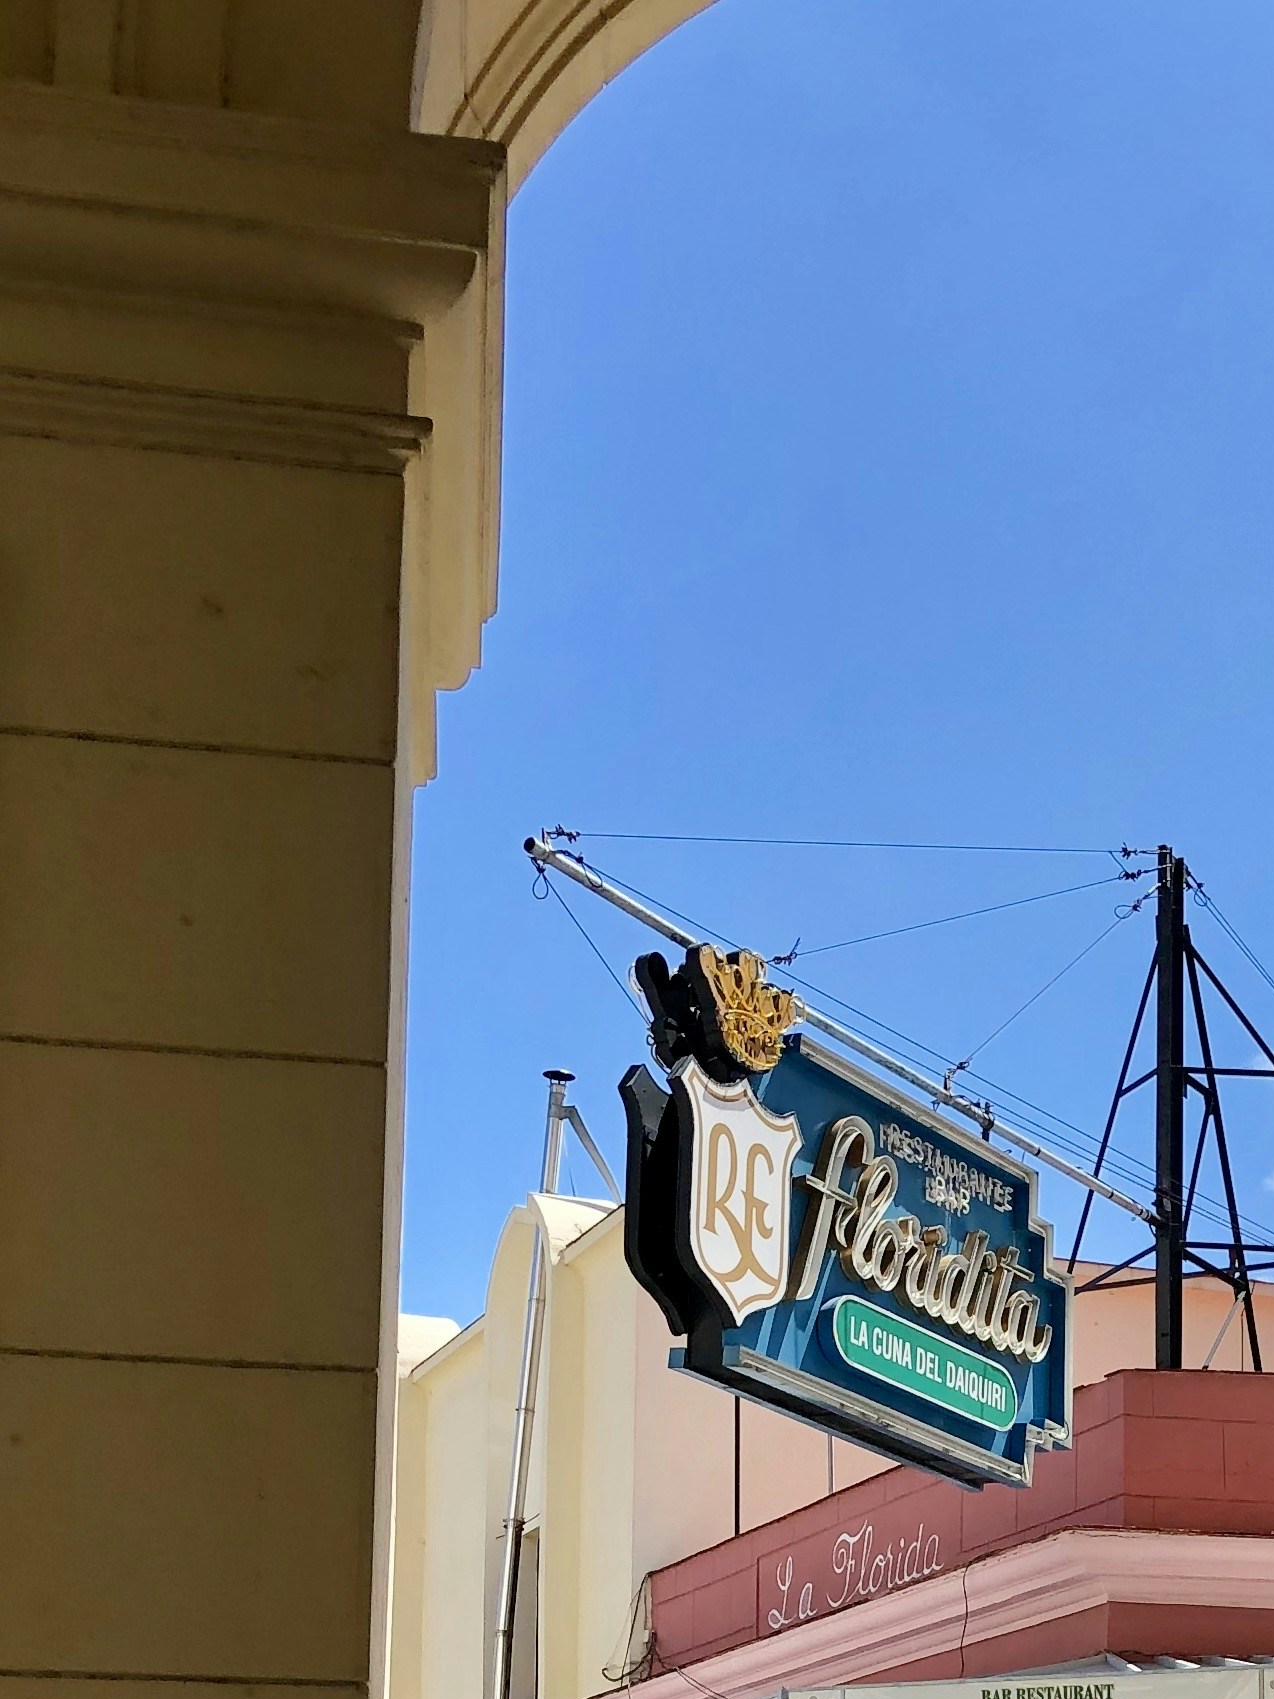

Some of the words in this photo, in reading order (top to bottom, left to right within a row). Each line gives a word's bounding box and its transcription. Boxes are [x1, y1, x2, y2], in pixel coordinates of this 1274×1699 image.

[850, 1315, 869, 1350] LA
[872, 1326, 913, 1370] CUNA
[915, 1346, 943, 1383] DEL
[946, 1360, 1007, 1413] DAIQUIRI
[767, 1555, 818, 1630] La
[826, 1519, 946, 1608] Florida
